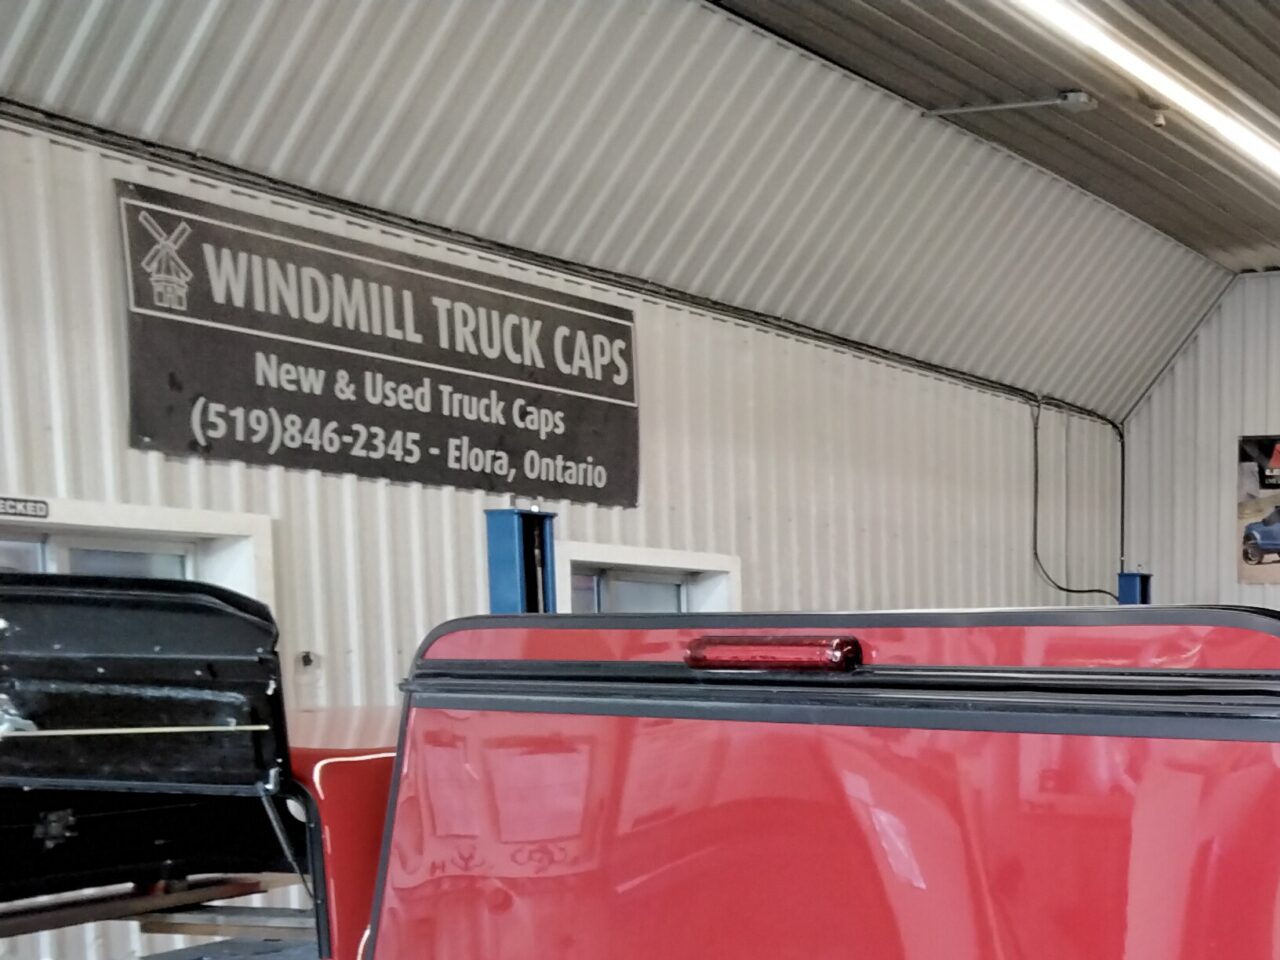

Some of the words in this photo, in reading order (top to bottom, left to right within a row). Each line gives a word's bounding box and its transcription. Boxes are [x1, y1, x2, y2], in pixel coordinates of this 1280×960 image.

[202, 242, 423, 344] WINDMILL
[432, 296, 546, 369] TRUCK
[553, 325, 629, 386] CAPS
[255, 351, 326, 395] New
[334, 369, 356, 400] &
[364, 371, 432, 413] Used
[438, 384, 506, 425] Truck
[512, 398, 566, 440] Caps
[191, 396, 421, 464] (519)846-2345
[428, 447, 440, 455] -
[447, 436, 516, 482] Elora,
[523, 450, 608, 488] Ontario
